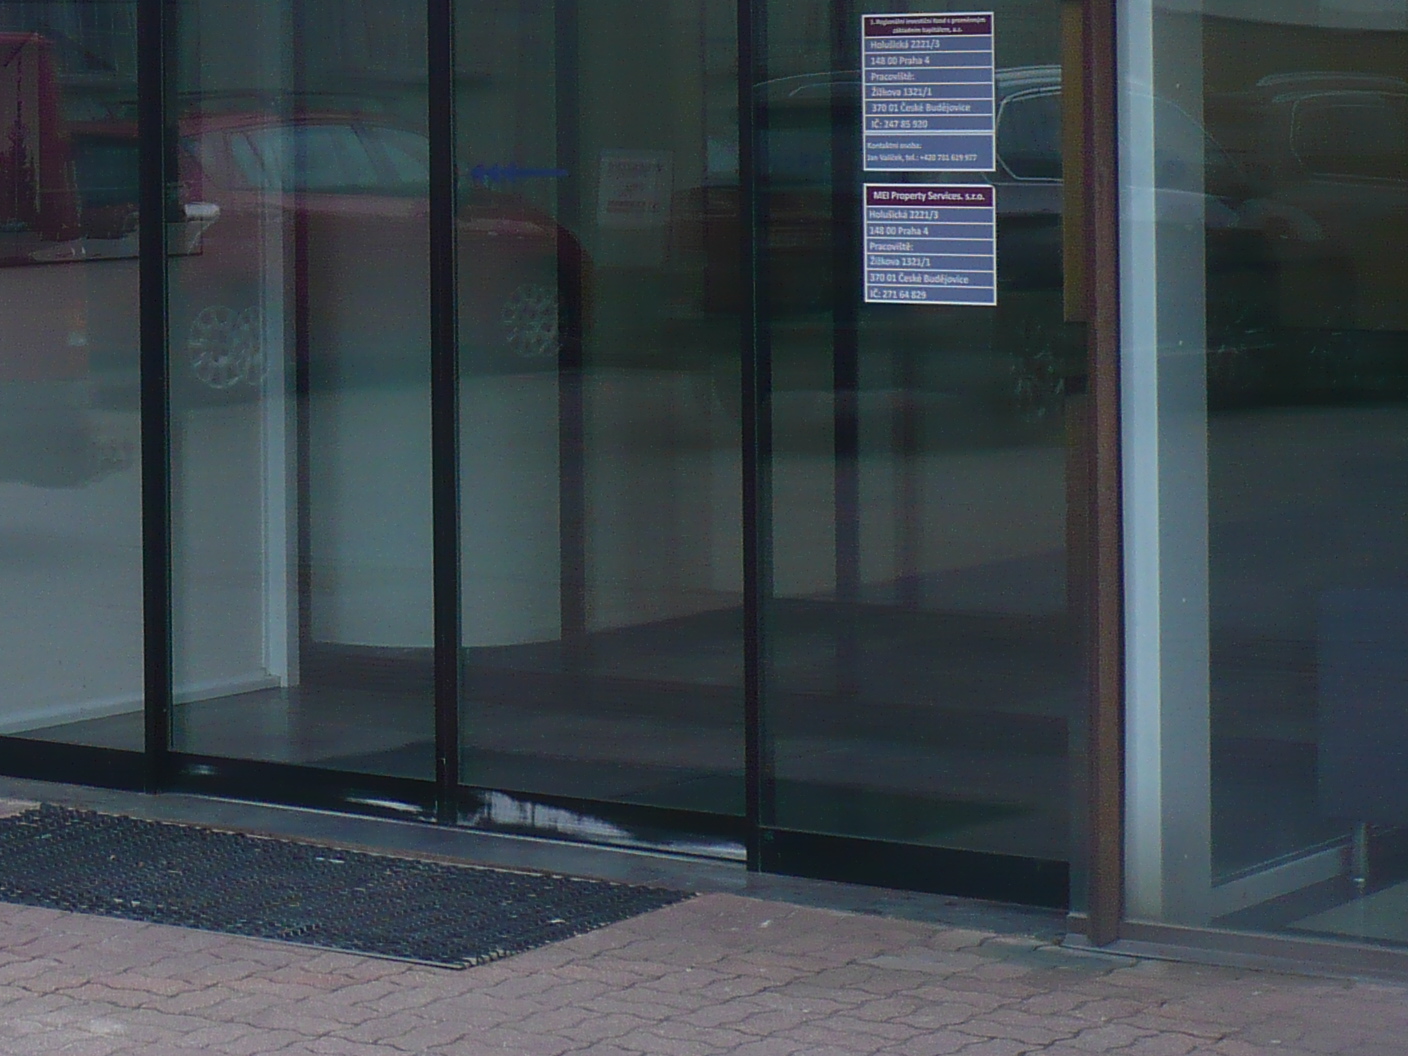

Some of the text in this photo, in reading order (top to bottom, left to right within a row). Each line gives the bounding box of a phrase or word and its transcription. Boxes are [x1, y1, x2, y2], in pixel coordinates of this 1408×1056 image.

[898, 56, 923, 65] Praha
[924, 56, 931, 65] 4
[871, 101, 972, 115] 370 01 České Budějovice
[873, 191, 890, 200] MEI
[891, 191, 927, 202] Property
[964, 193, 986, 201] s.r.o.
[869, 209, 909, 219] Holušická
[869, 227, 930, 236] 148 00 Praha 4
[870, 271, 970, 285] 370 01 České Budějovice
